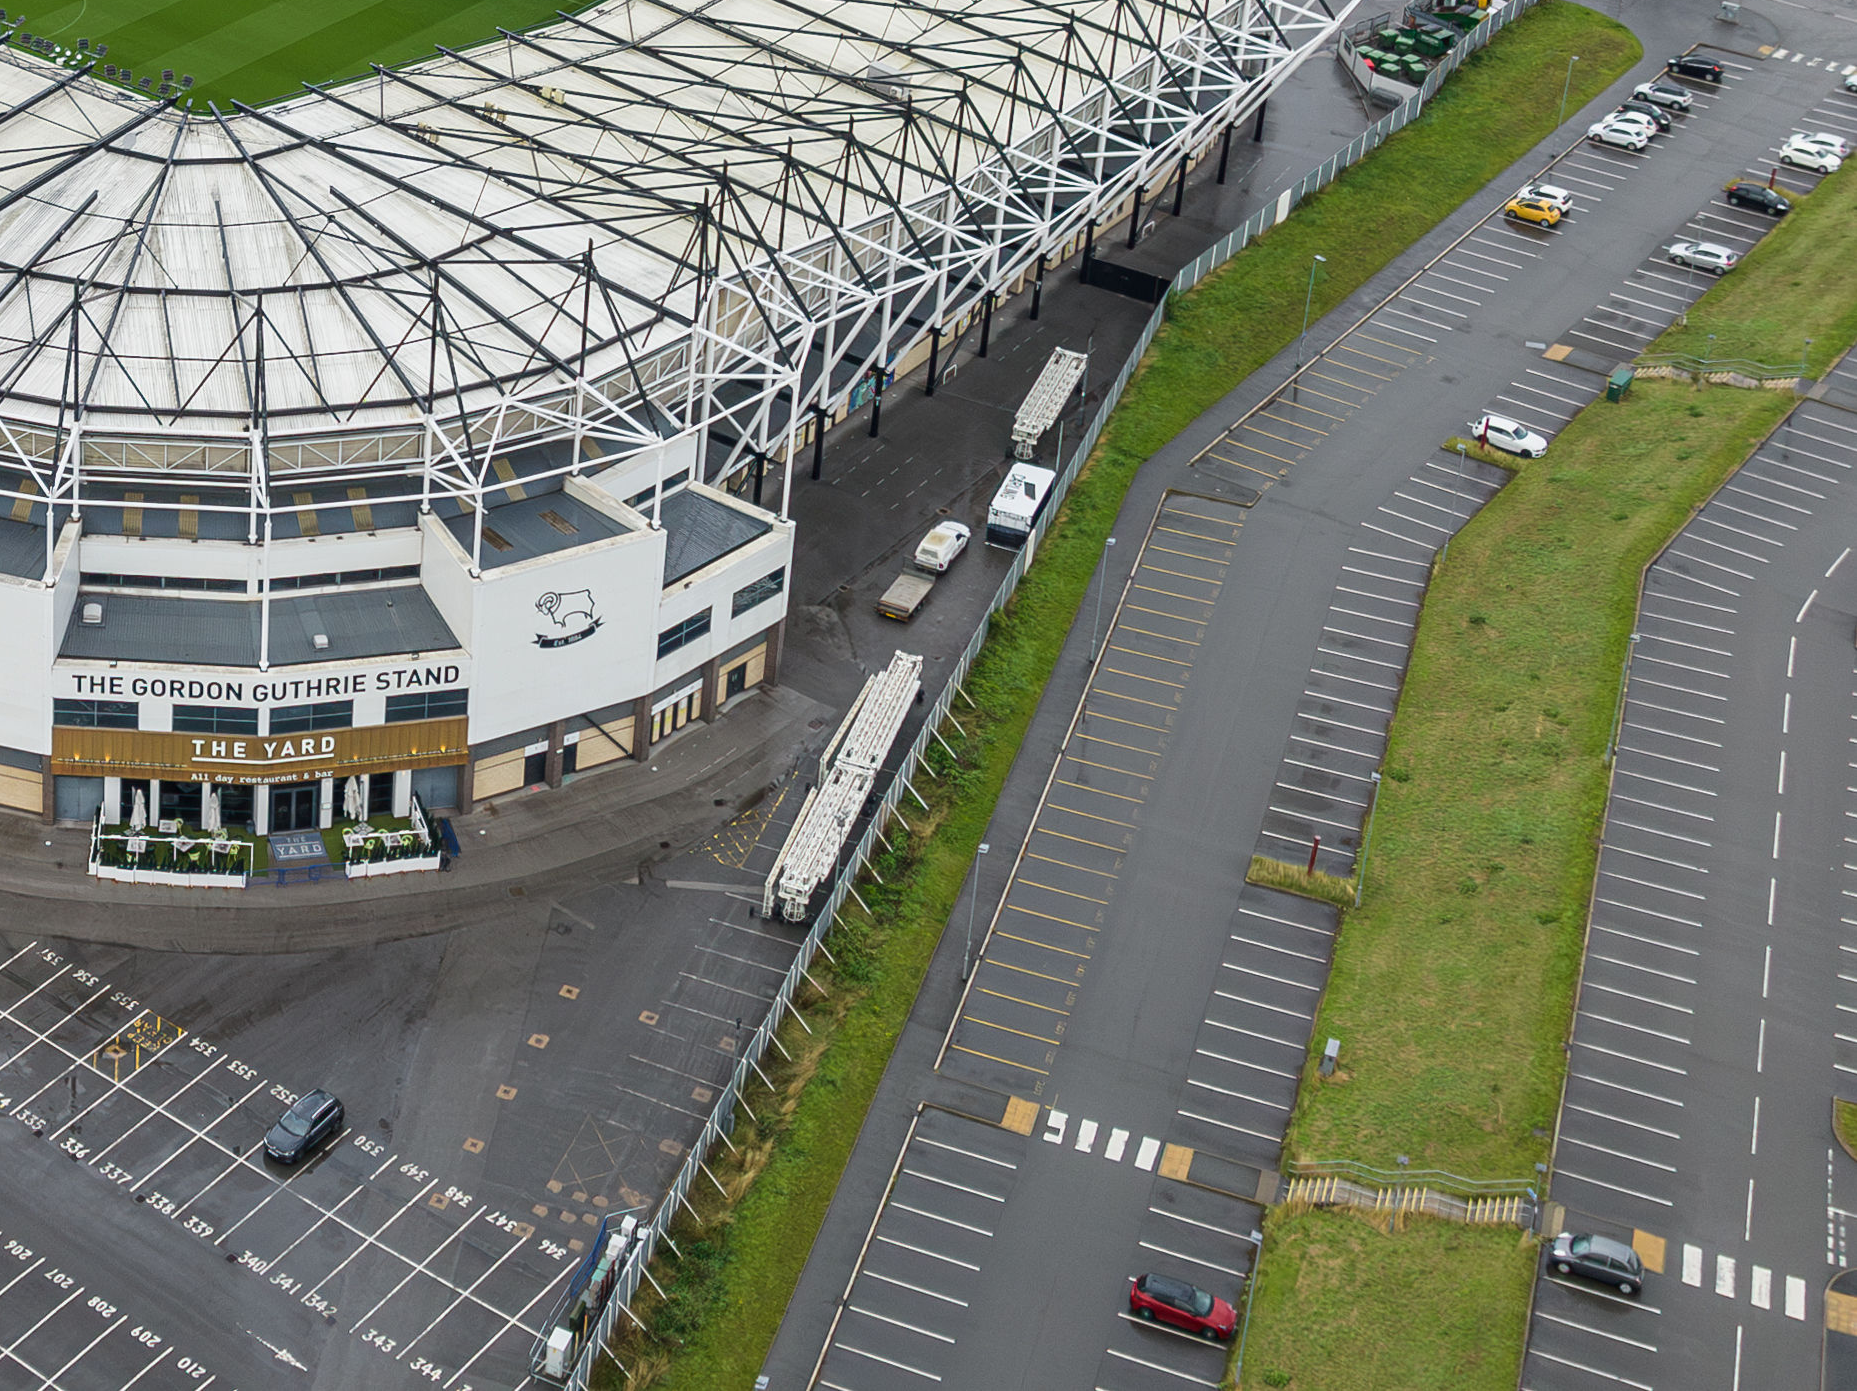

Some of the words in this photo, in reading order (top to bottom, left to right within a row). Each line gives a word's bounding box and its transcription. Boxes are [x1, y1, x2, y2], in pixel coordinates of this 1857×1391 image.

[72, 674, 124, 696] THE
[131, 677, 243, 702] GORDON
[252, 674, 367, 703] GUTHRIE
[375, 665, 460, 690] STAND
[192, 739, 247, 758] THE
[263, 736, 336, 759] YARD
[191, 773, 209, 781] All
[215, 774, 234, 783] day
[239, 772, 297, 784] restaurant
[303, 771, 310, 780] &
[276, 844, 322, 856] YARD
[227, 1060, 257, 1081] 353
[17, 1109, 46, 1129] 335
[60, 1138, 90, 1158] 336
[99, 1162, 133, 1184] 337
[146, 1192, 175, 1214] 338
[184, 1216, 213, 1237] 339
[4, 1240, 33, 1260] 206
[270, 1273, 302, 1295] 341
[88, 1296, 117, 1318] 208
[362, 1329, 396, 1352] 343
